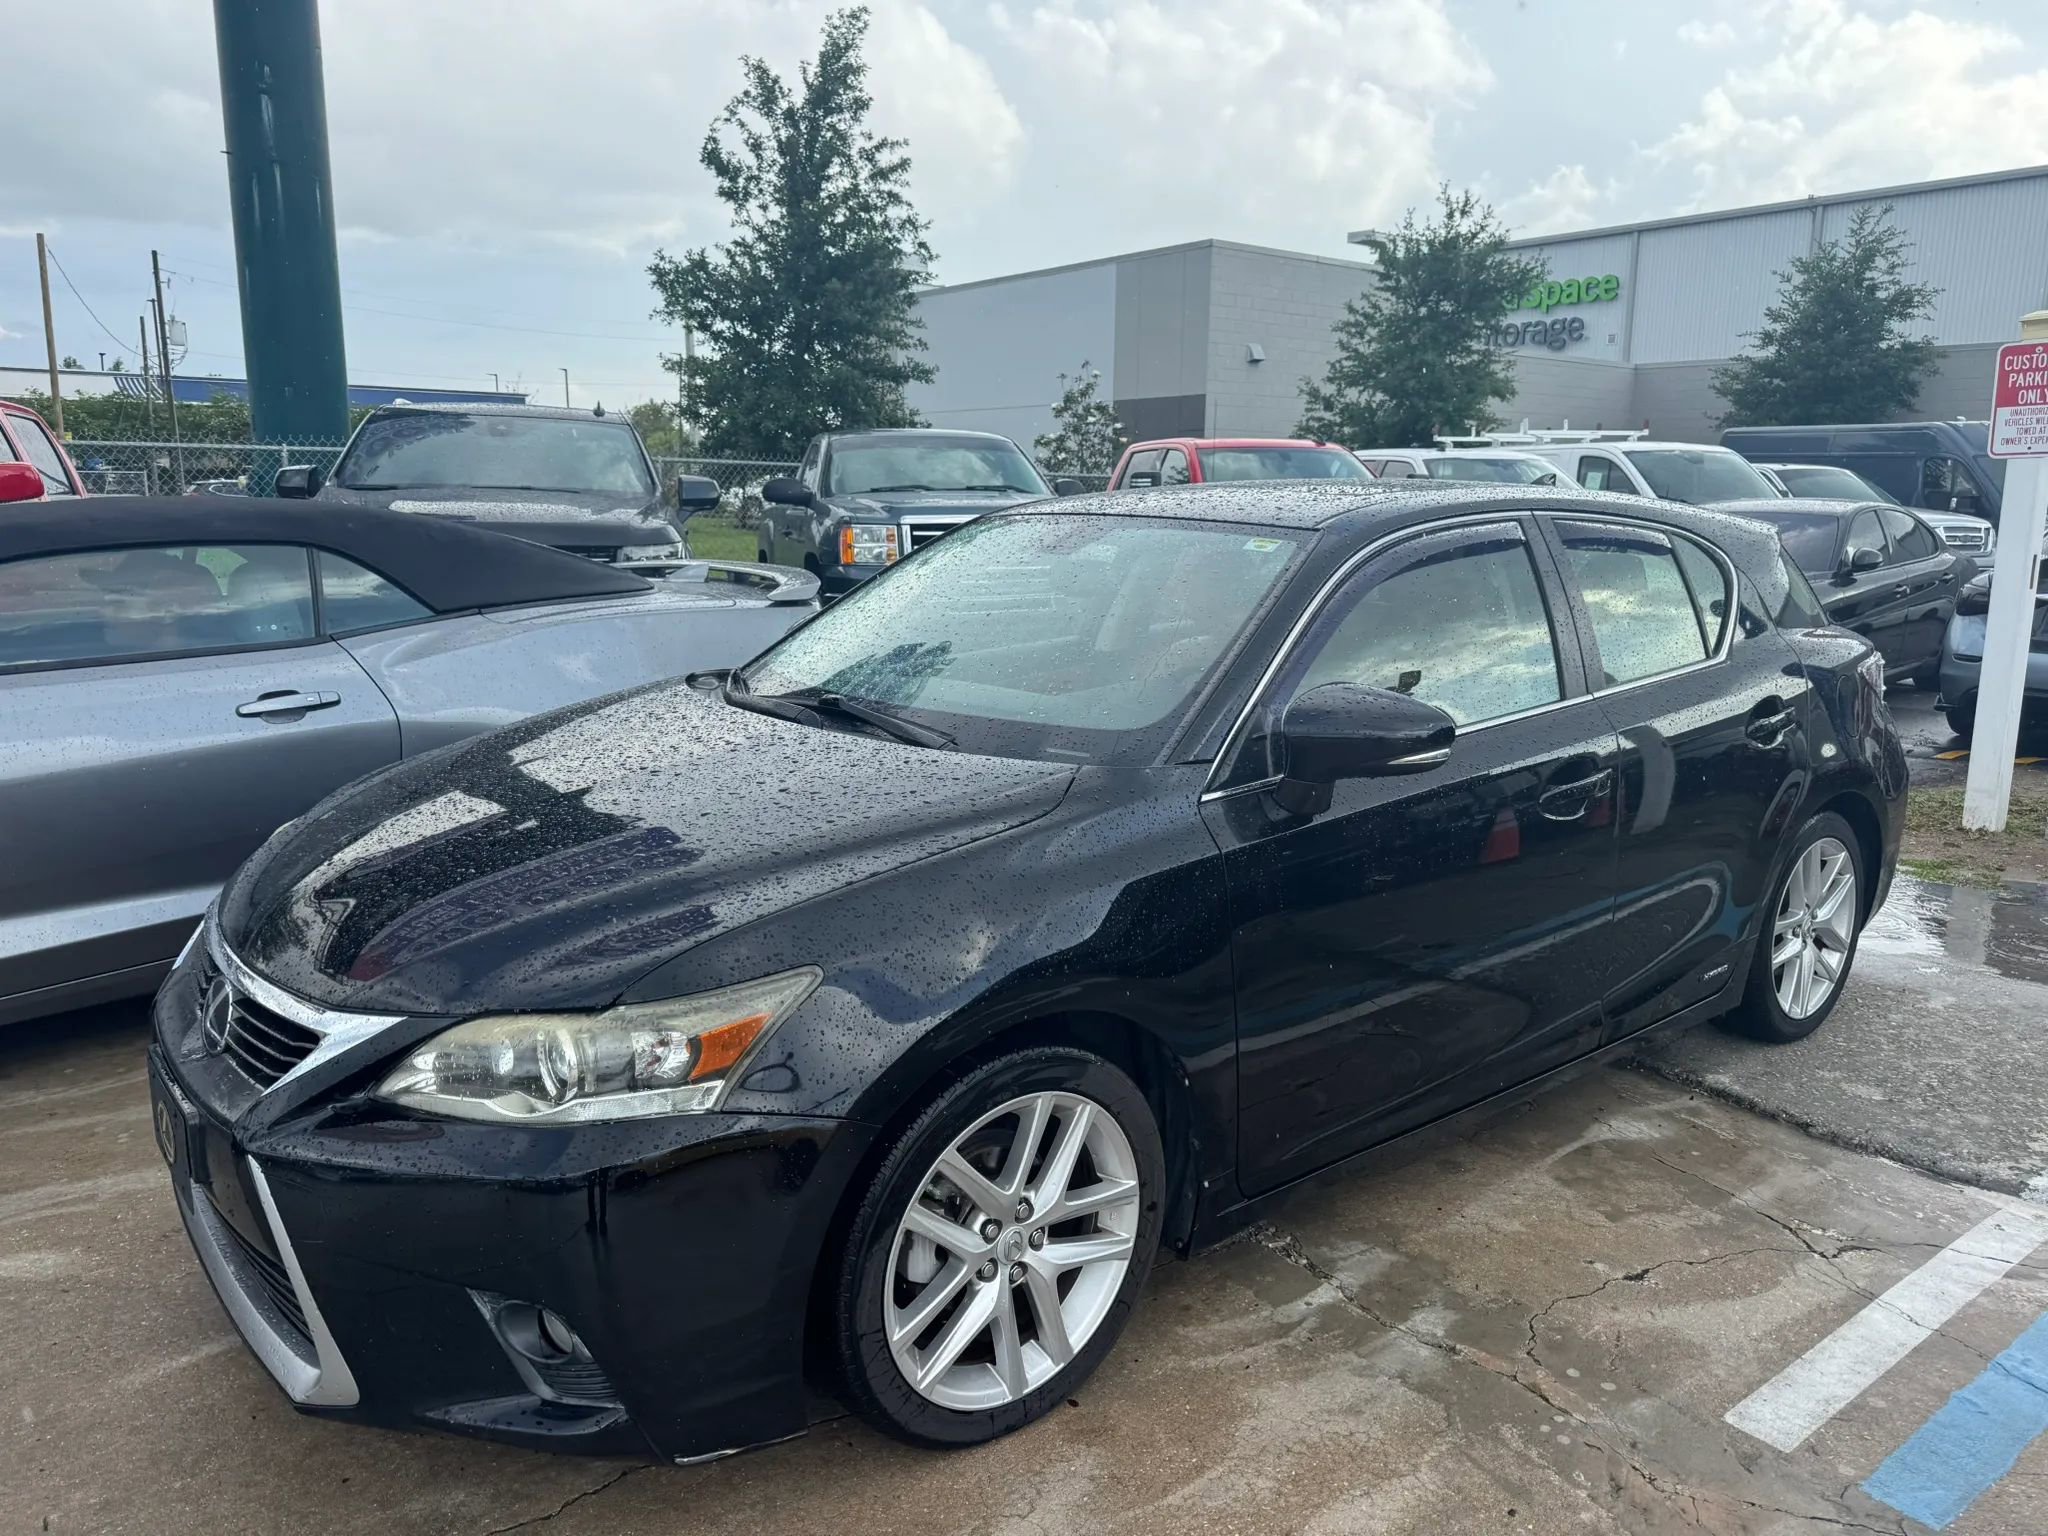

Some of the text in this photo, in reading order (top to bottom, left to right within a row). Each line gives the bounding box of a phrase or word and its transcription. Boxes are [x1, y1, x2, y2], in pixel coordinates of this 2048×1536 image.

[1503, 273, 1619, 313] Space
[1484, 316, 1585, 352] orage
[2004, 353, 2048, 371] CUSTO
[2005, 417, 2033, 427] VEHICLES
[2016, 426, 2047, 436] TOWED AT
[2000, 437, 2028, 446] OWNER'S
